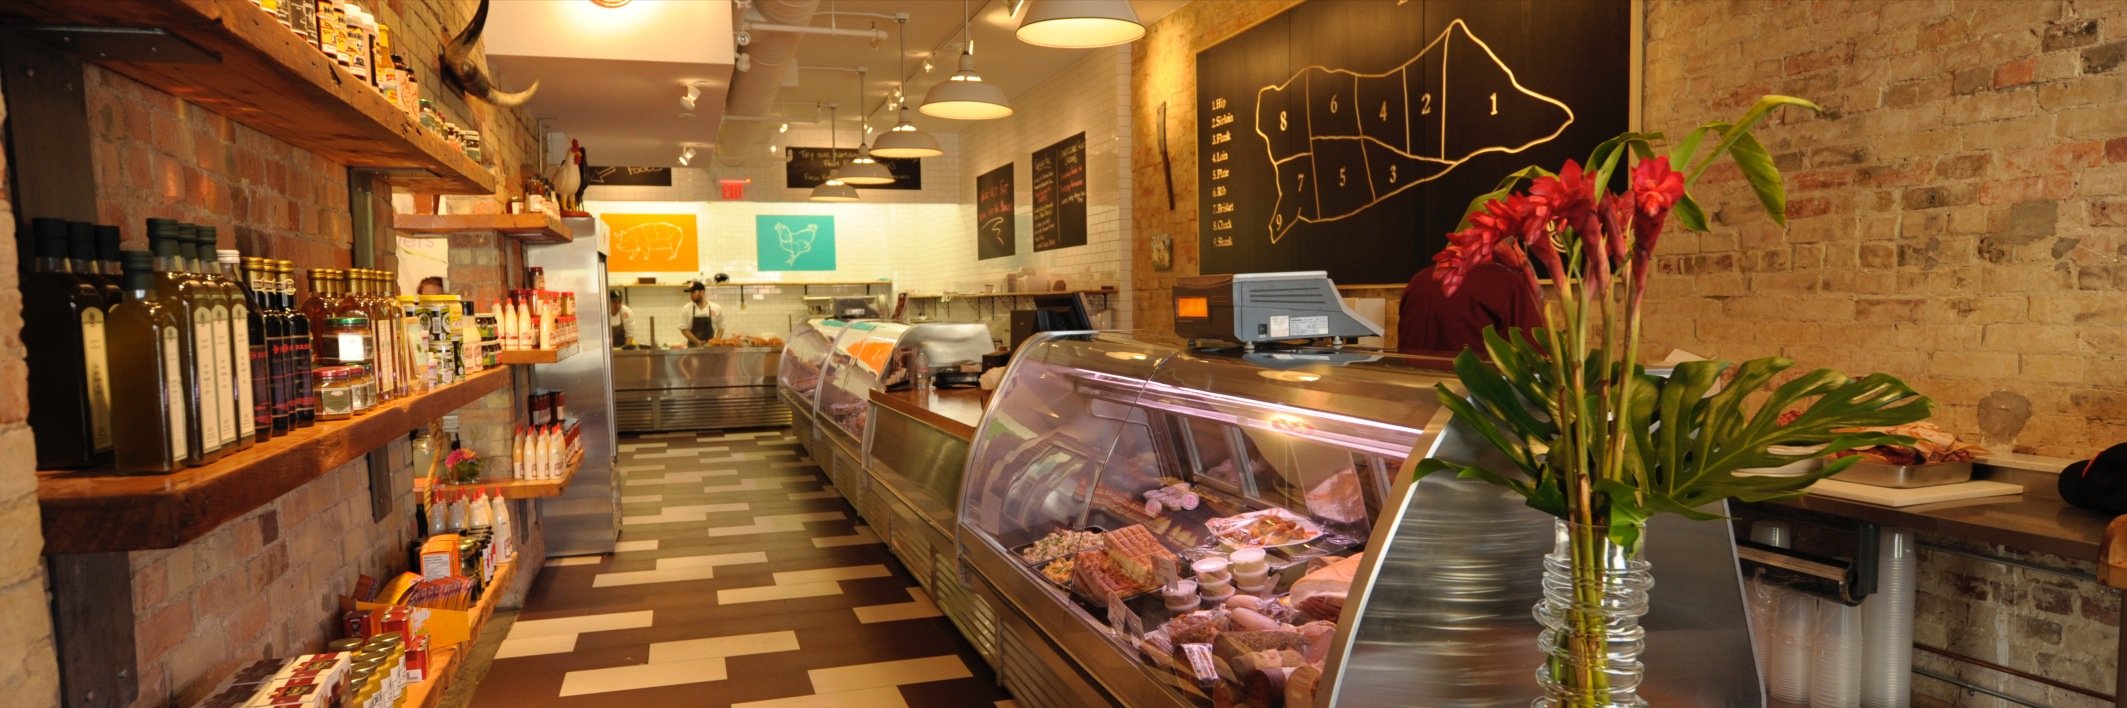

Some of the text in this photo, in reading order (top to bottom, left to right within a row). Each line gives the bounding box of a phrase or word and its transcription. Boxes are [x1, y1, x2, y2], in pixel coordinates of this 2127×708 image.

[1330, 94, 1338, 114] 6
[1380, 100, 1388, 122] 4
[1421, 93, 1432, 115] 2
[1490, 92, 1499, 116] 1
[1280, 110, 1288, 132] 8
[1297, 173, 1305, 192] 7
[1339, 166, 1346, 187] 5
[1389, 164, 1397, 184] 3
[1276, 213, 1283, 231] 9
